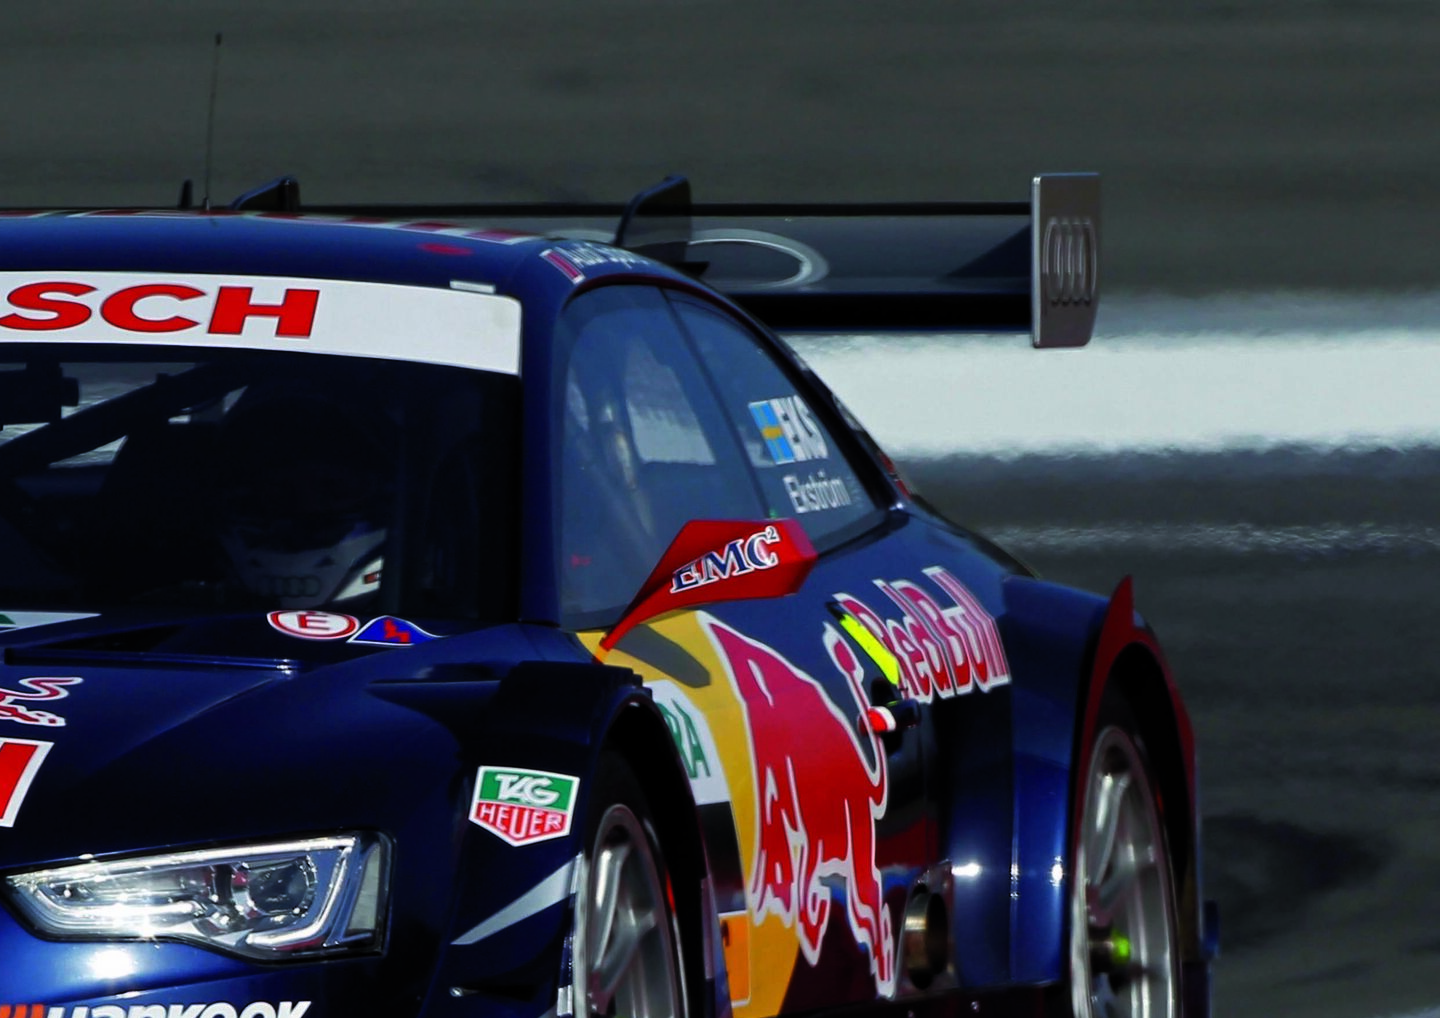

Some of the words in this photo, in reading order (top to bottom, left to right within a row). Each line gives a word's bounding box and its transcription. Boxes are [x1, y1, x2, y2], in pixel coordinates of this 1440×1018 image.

[832, 579, 956, 704] Red
[890, 565, 1012, 695] Bull
[479, 803, 563, 839] HEUER
[495, 773, 560, 806] TAG
